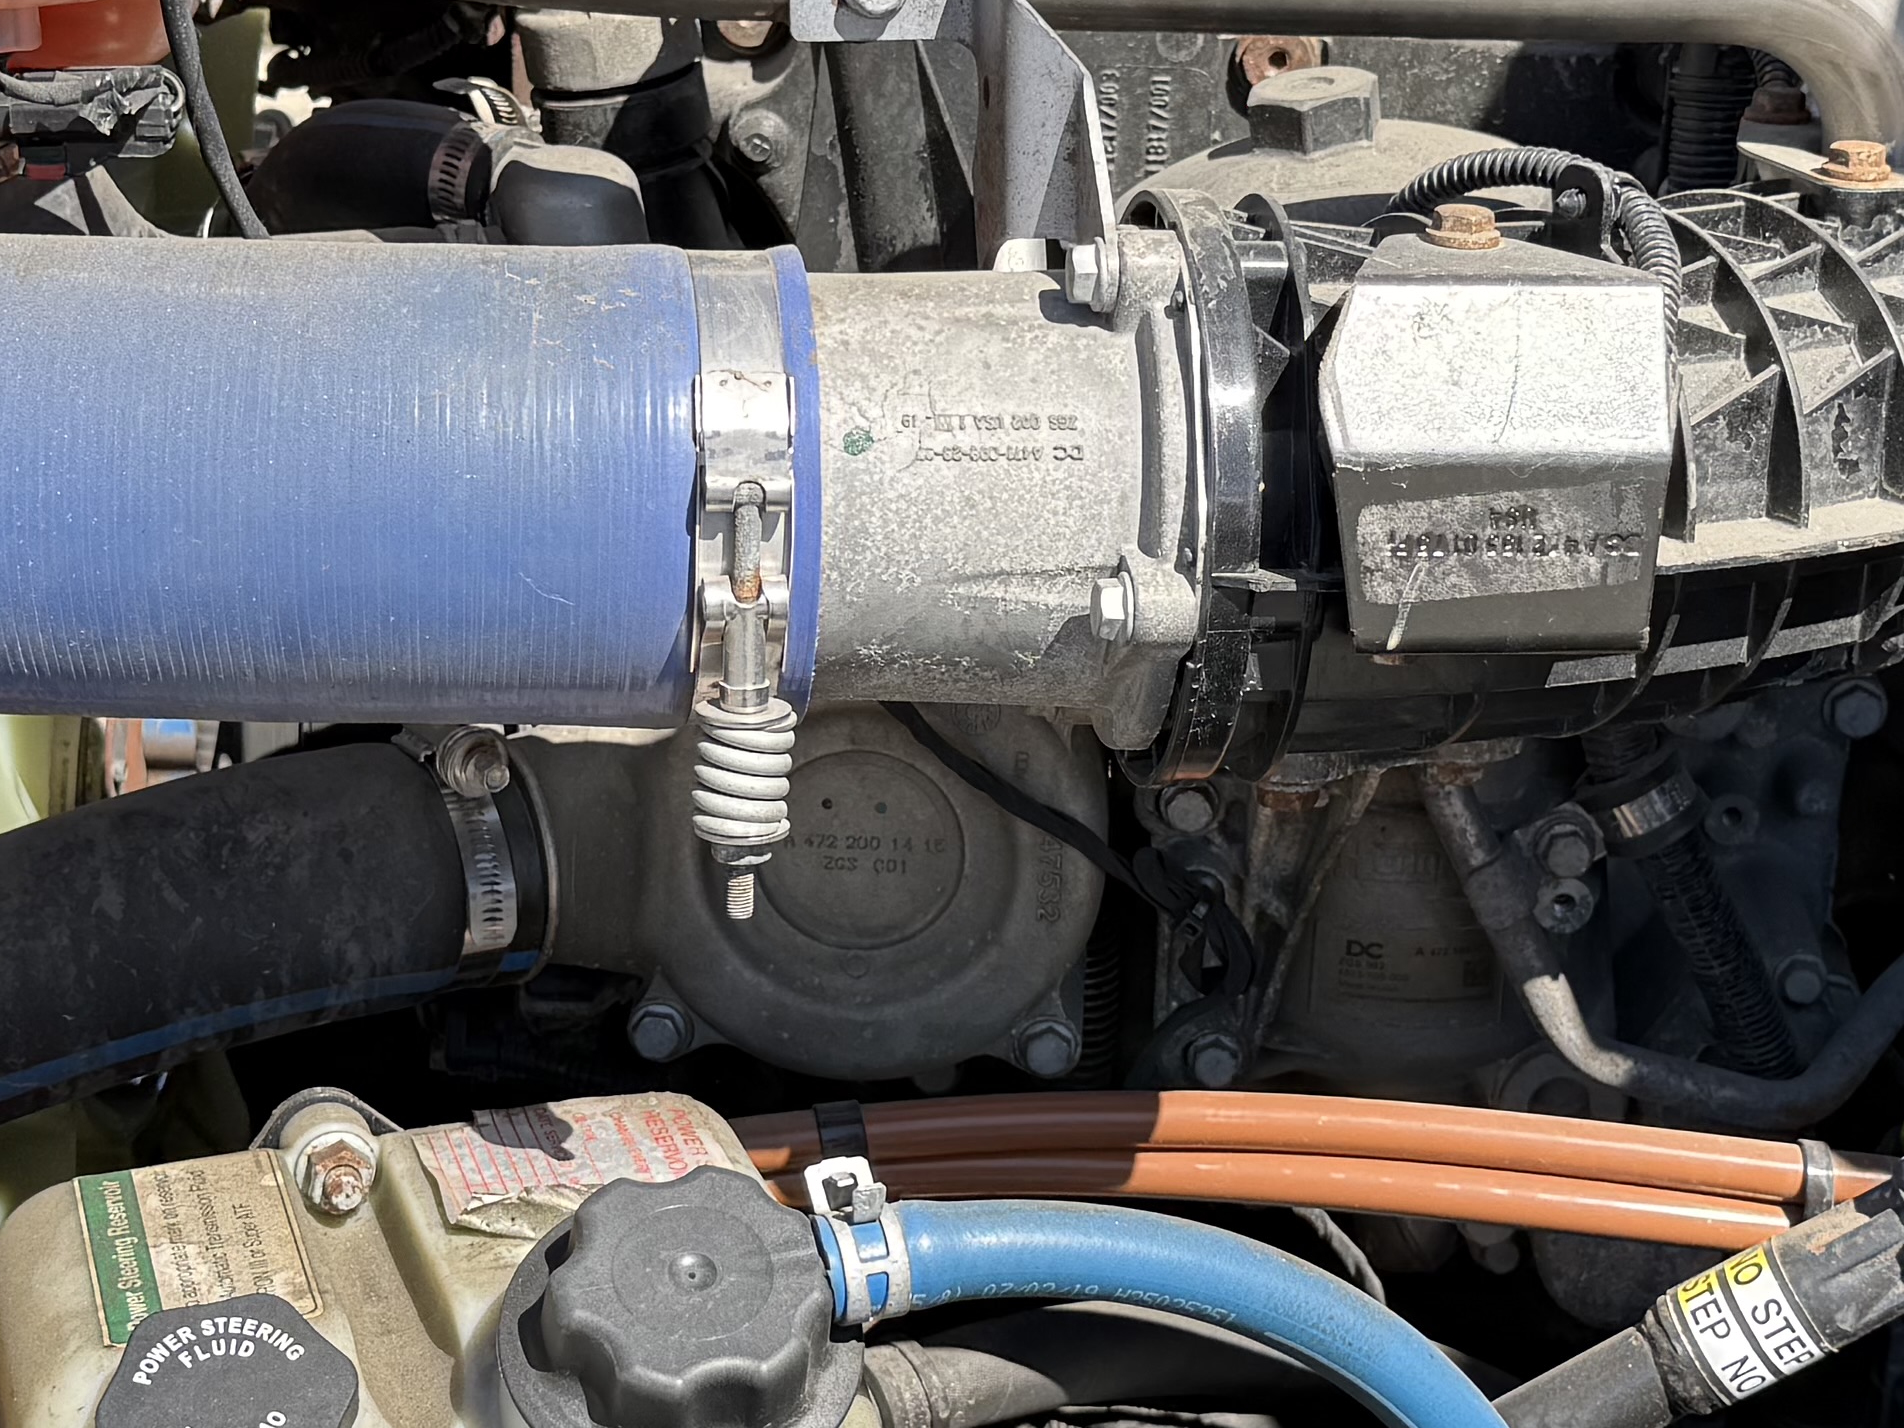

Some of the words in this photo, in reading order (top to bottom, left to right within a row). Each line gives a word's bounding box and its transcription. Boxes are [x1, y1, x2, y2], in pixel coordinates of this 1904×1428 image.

[98, 1180, 131, 1237] Reservoir
[111, 1235, 143, 1290] Steering
[1681, 1275, 1732, 1339] STEP
[1721, 1354, 1766, 1393] NO
[1729, 1250, 1763, 1285] NO
[1751, 1298, 1816, 1367] STEP
[133, 1326, 197, 1386] POWER
[200, 1317, 305, 1361] STEERING
[177, 1338, 255, 1369] FLUID
